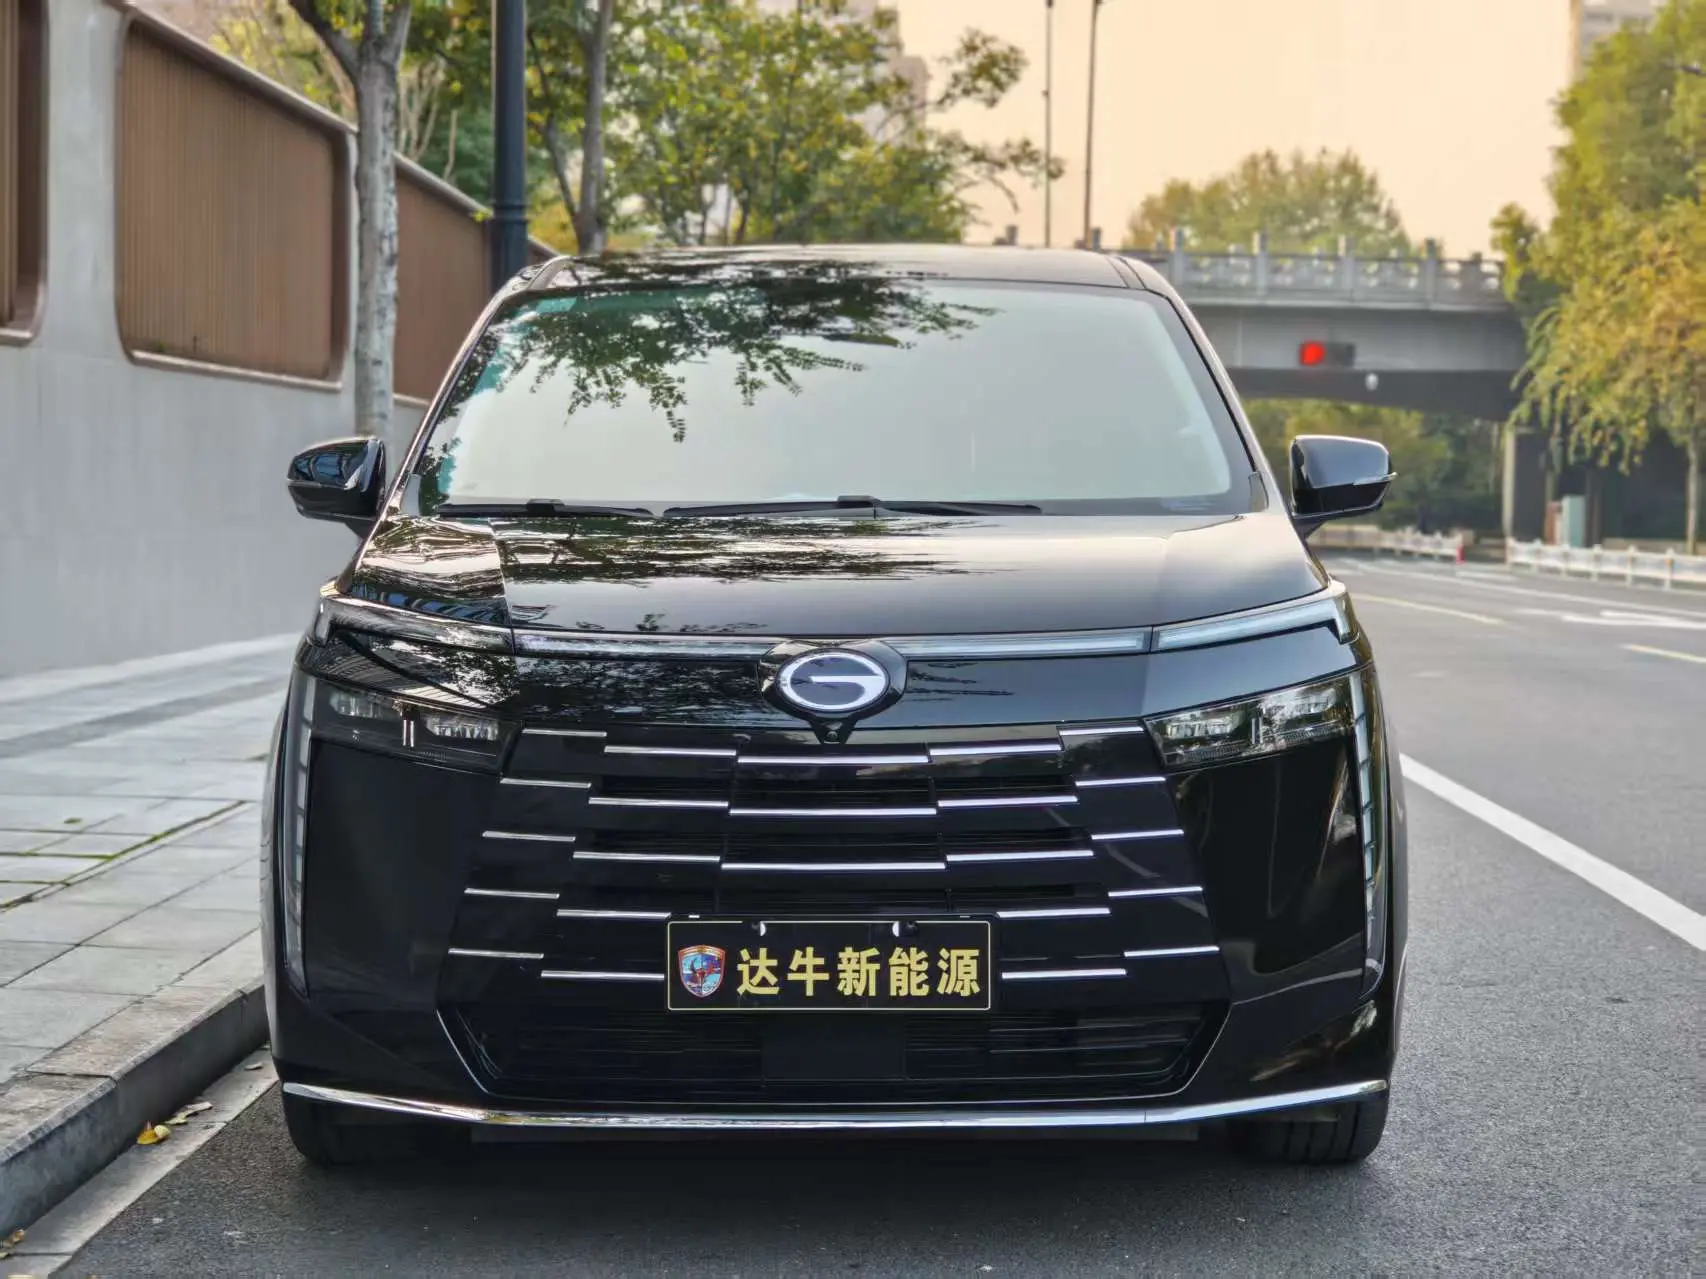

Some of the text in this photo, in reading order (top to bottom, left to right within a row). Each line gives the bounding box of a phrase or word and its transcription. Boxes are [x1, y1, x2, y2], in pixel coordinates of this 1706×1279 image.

[736, 946, 981, 997] 达牛新能源
